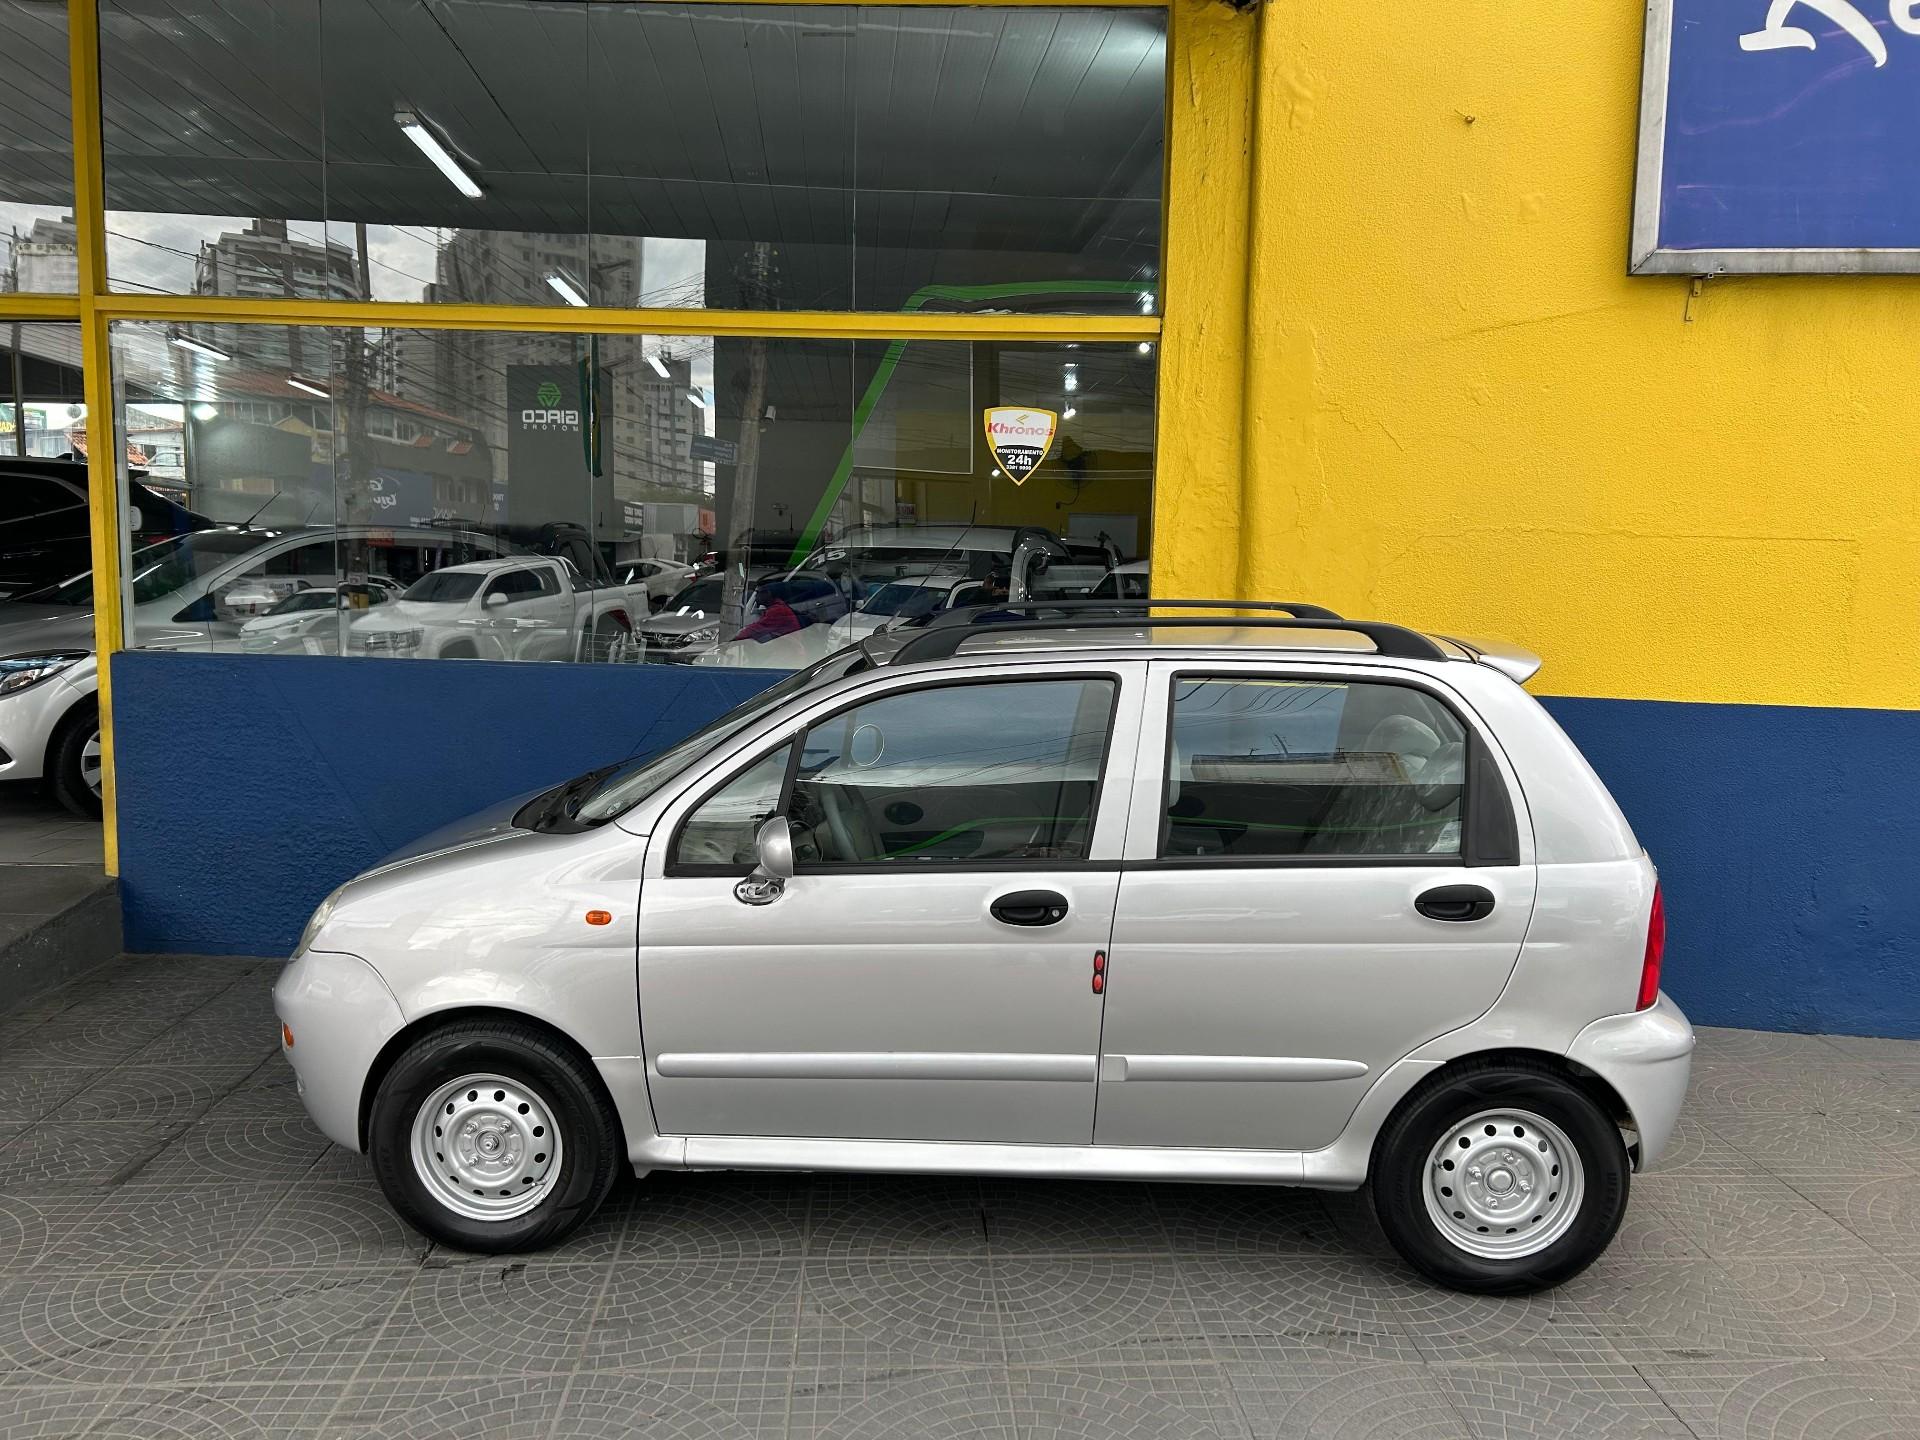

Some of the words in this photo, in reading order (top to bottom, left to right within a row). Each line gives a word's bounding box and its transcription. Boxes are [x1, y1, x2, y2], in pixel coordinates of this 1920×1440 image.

[988, 423, 1053, 436] Khronos
[996, 448, 1044, 456] MONITORAMENTO
[1007, 454, 1032, 465] 24h
